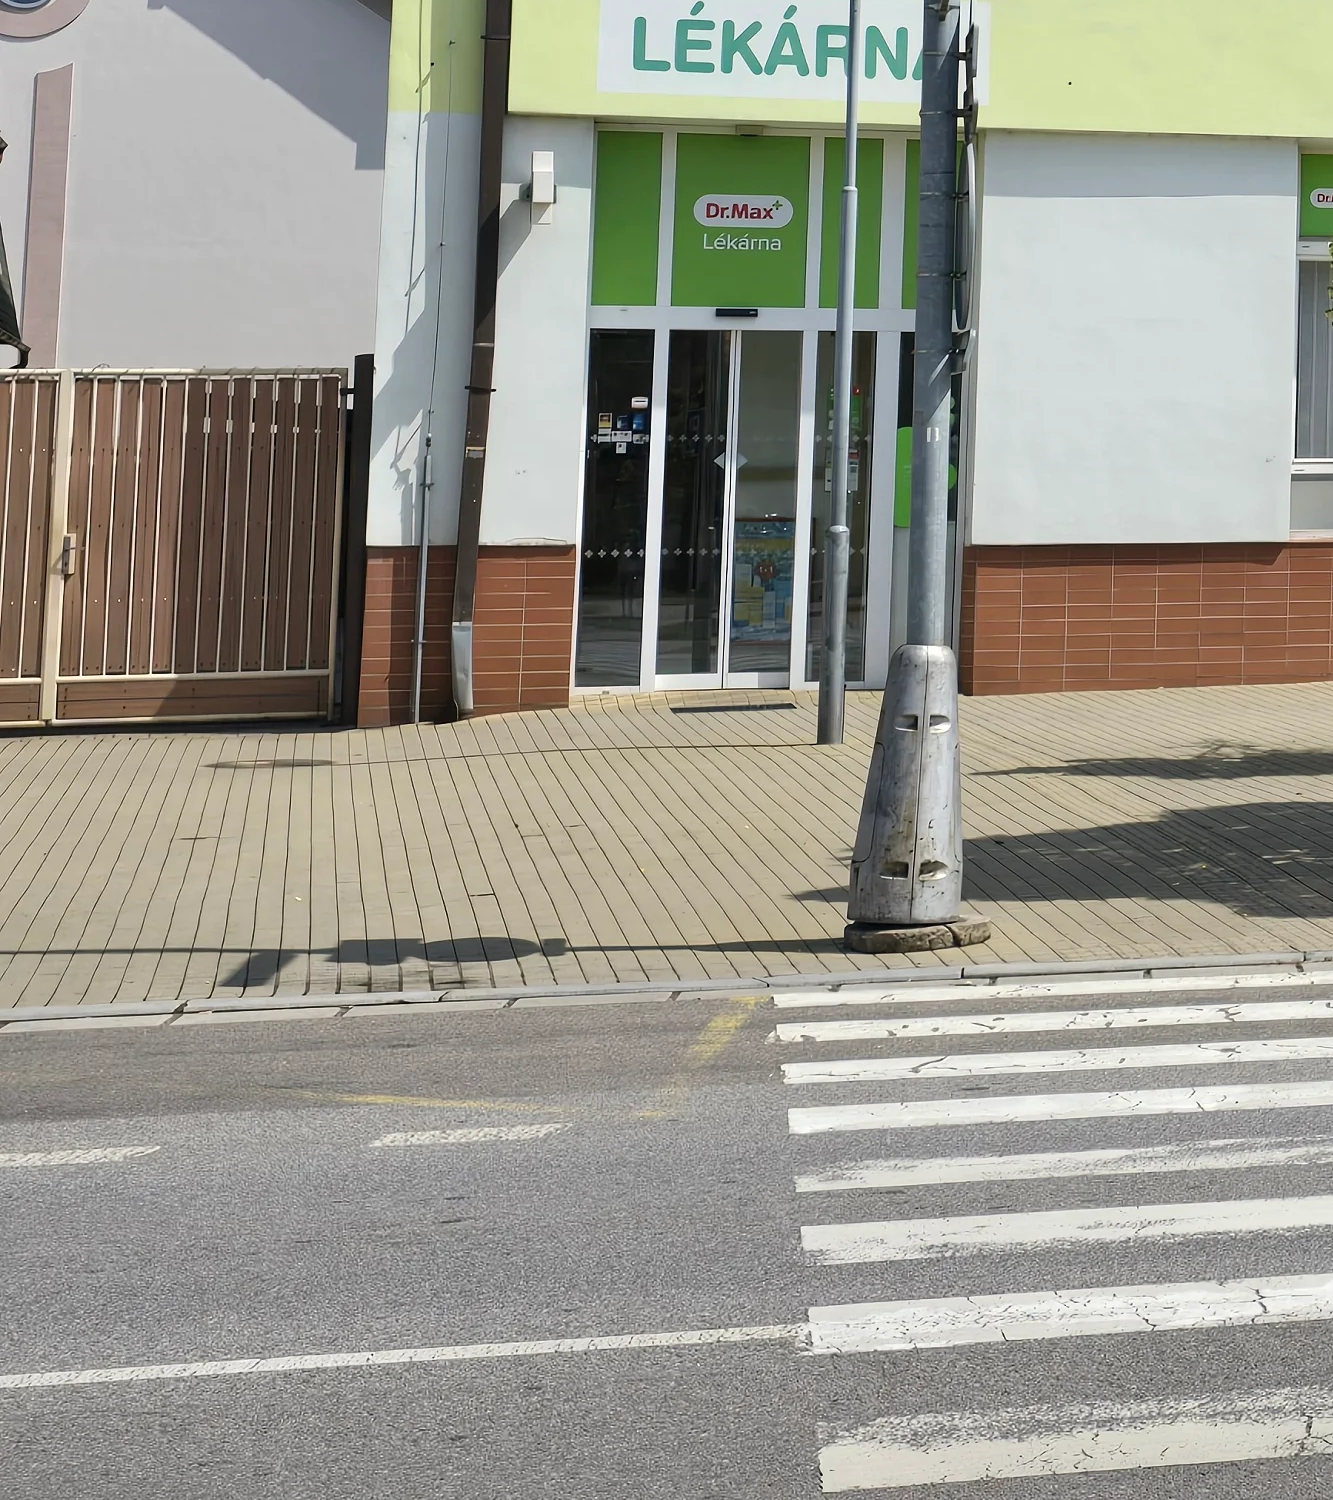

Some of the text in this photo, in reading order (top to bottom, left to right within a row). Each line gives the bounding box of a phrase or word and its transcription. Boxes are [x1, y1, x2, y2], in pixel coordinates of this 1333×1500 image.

[632, 0, 923, 81] LÉKÁRN
[705, 202, 774, 220] Dr.Max
[703, 233, 782, 251] Lékárna
